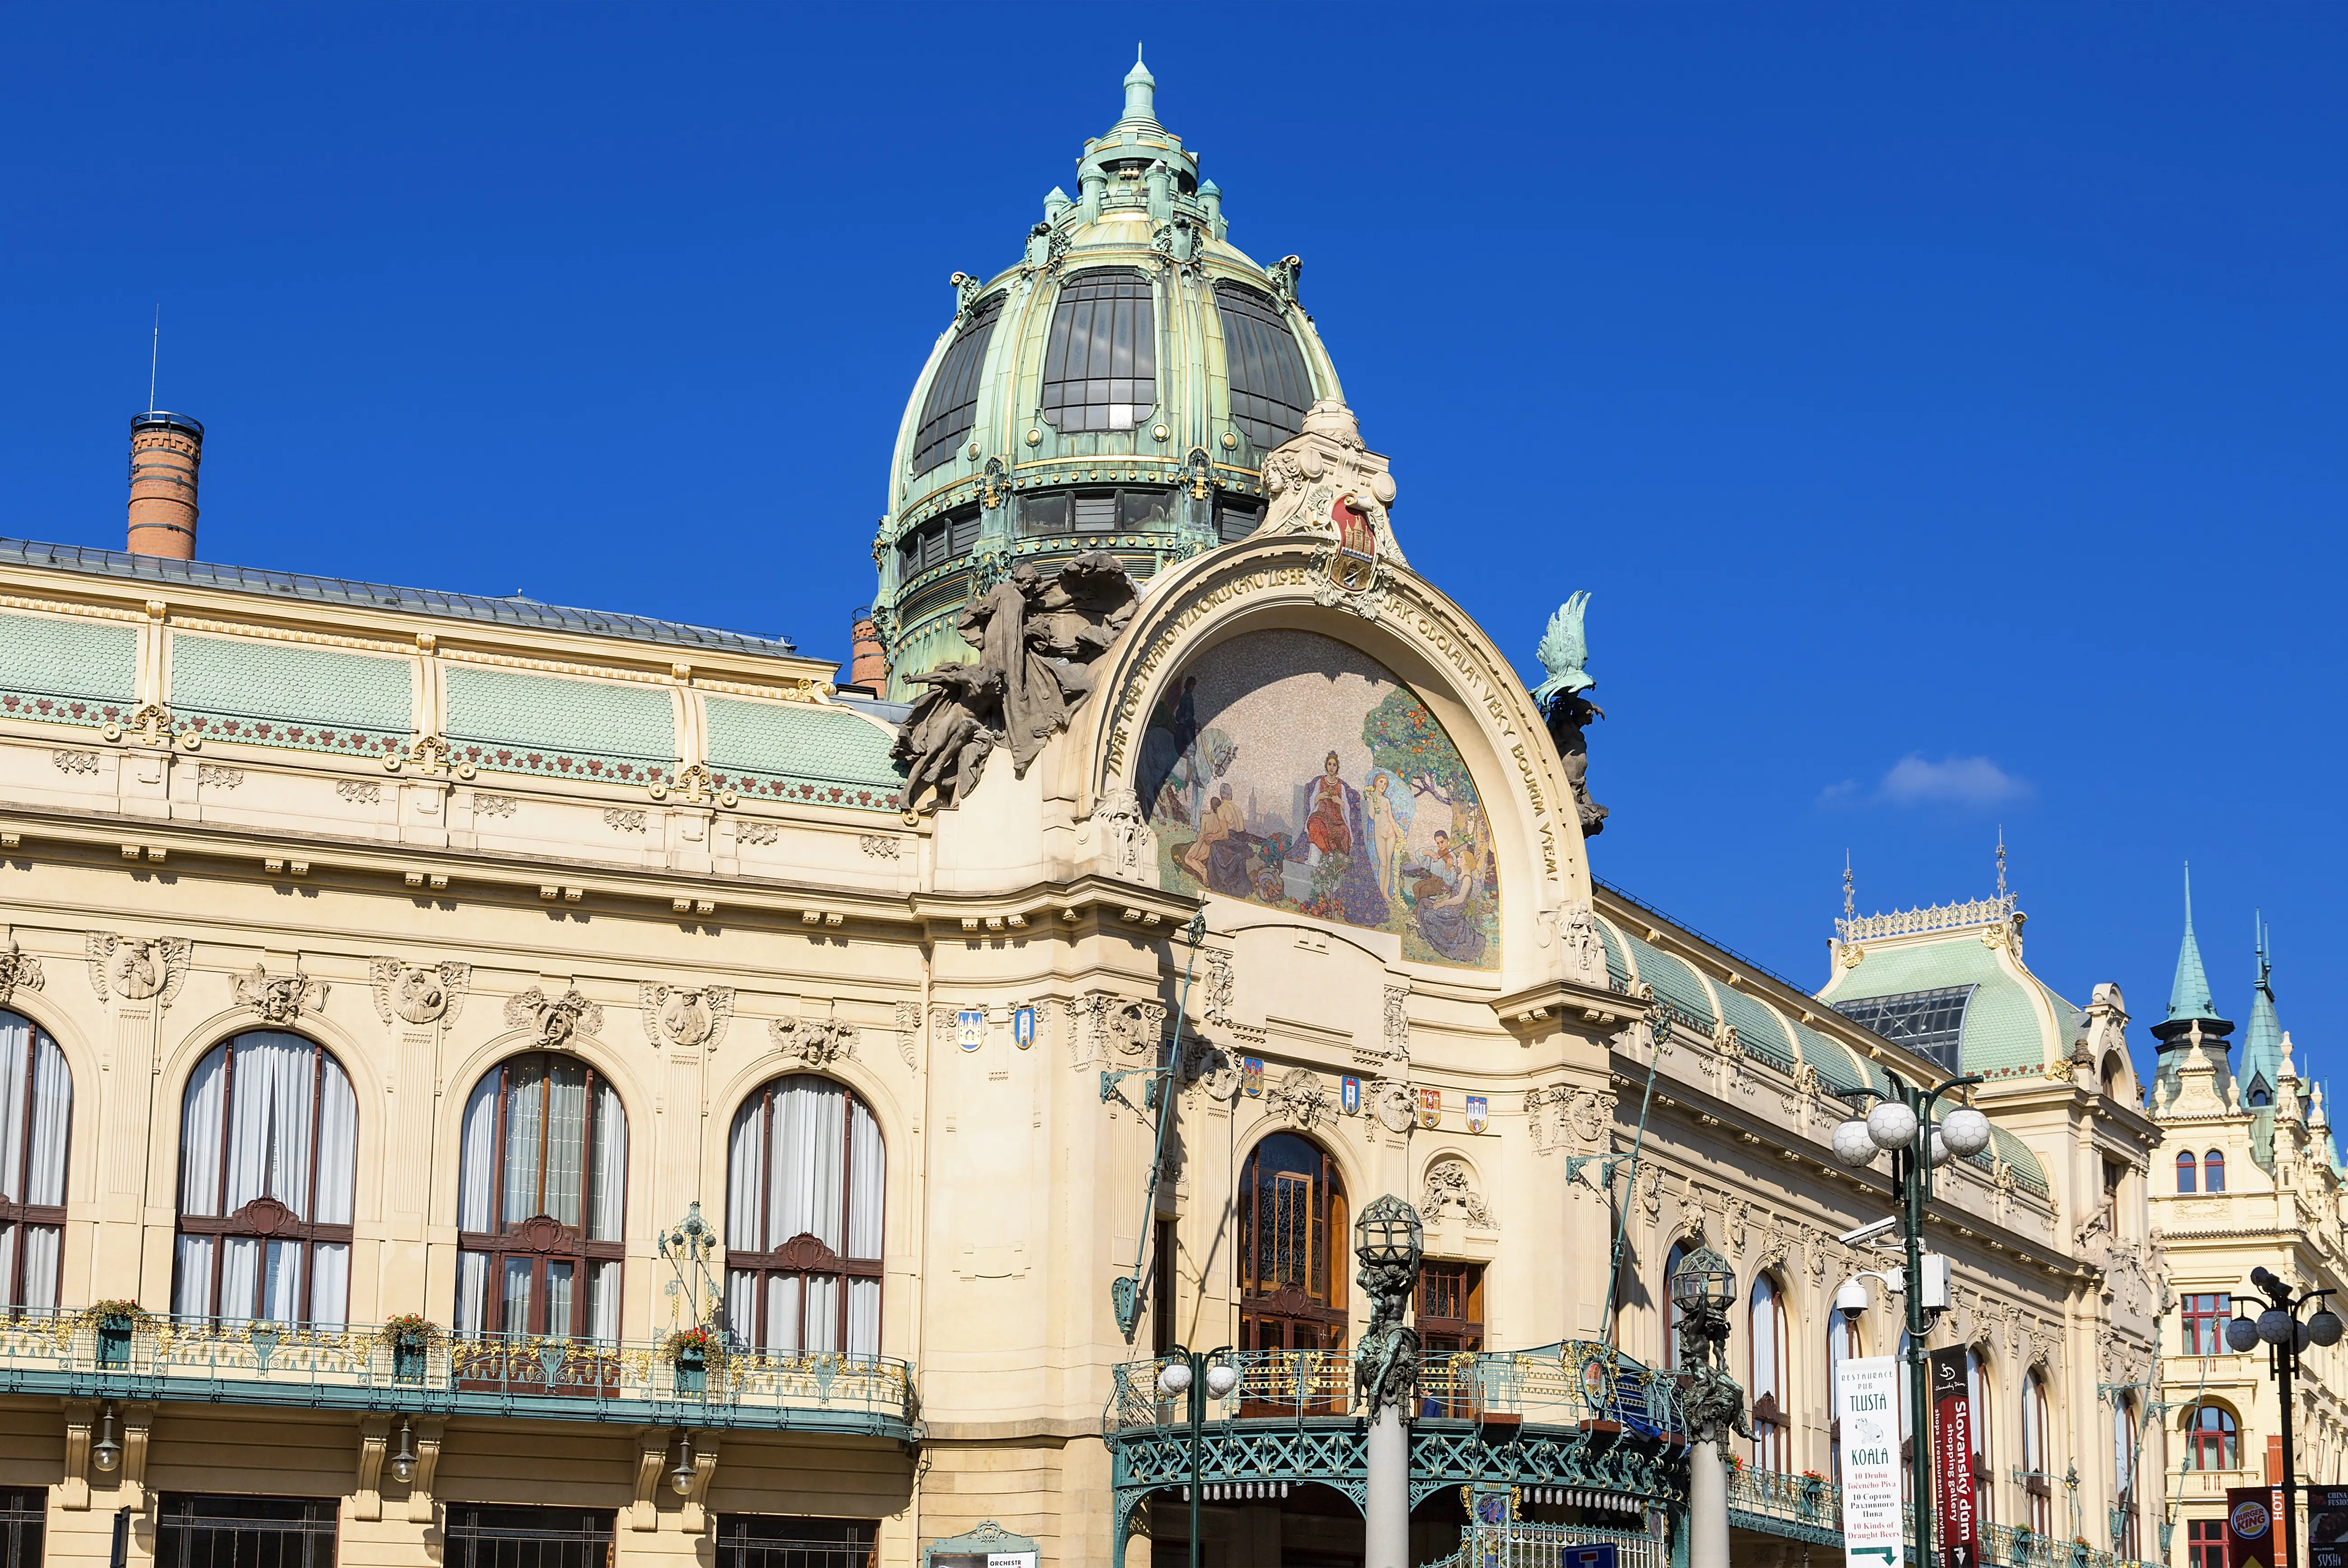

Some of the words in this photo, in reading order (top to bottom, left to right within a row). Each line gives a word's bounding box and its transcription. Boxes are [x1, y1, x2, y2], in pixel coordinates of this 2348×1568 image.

[1383, 594, 1414, 625] JAK
[1417, 618, 1481, 688] ODOLALAS
[1106, 725, 1129, 778] ZDAR
[1842, 1371, 1893, 1381] RESTAURACE
[1850, 1391, 1887, 1411] TLUSTÁ
[1852, 1448, 1889, 1465] KOALA
[1947, 1423, 1956, 1478] shopping
[1955, 1401, 1970, 1495] Slovanský
[1847, 1481, 1879, 1489] Točeného
[1863, 1493, 1891, 1501] Сортов
[1948, 1480, 1957, 1521] gallery
[1960, 1498, 1971, 1540] dům
[2236, 1508, 2264, 1523] BURGER
[2237, 1515, 2265, 1532] KING
